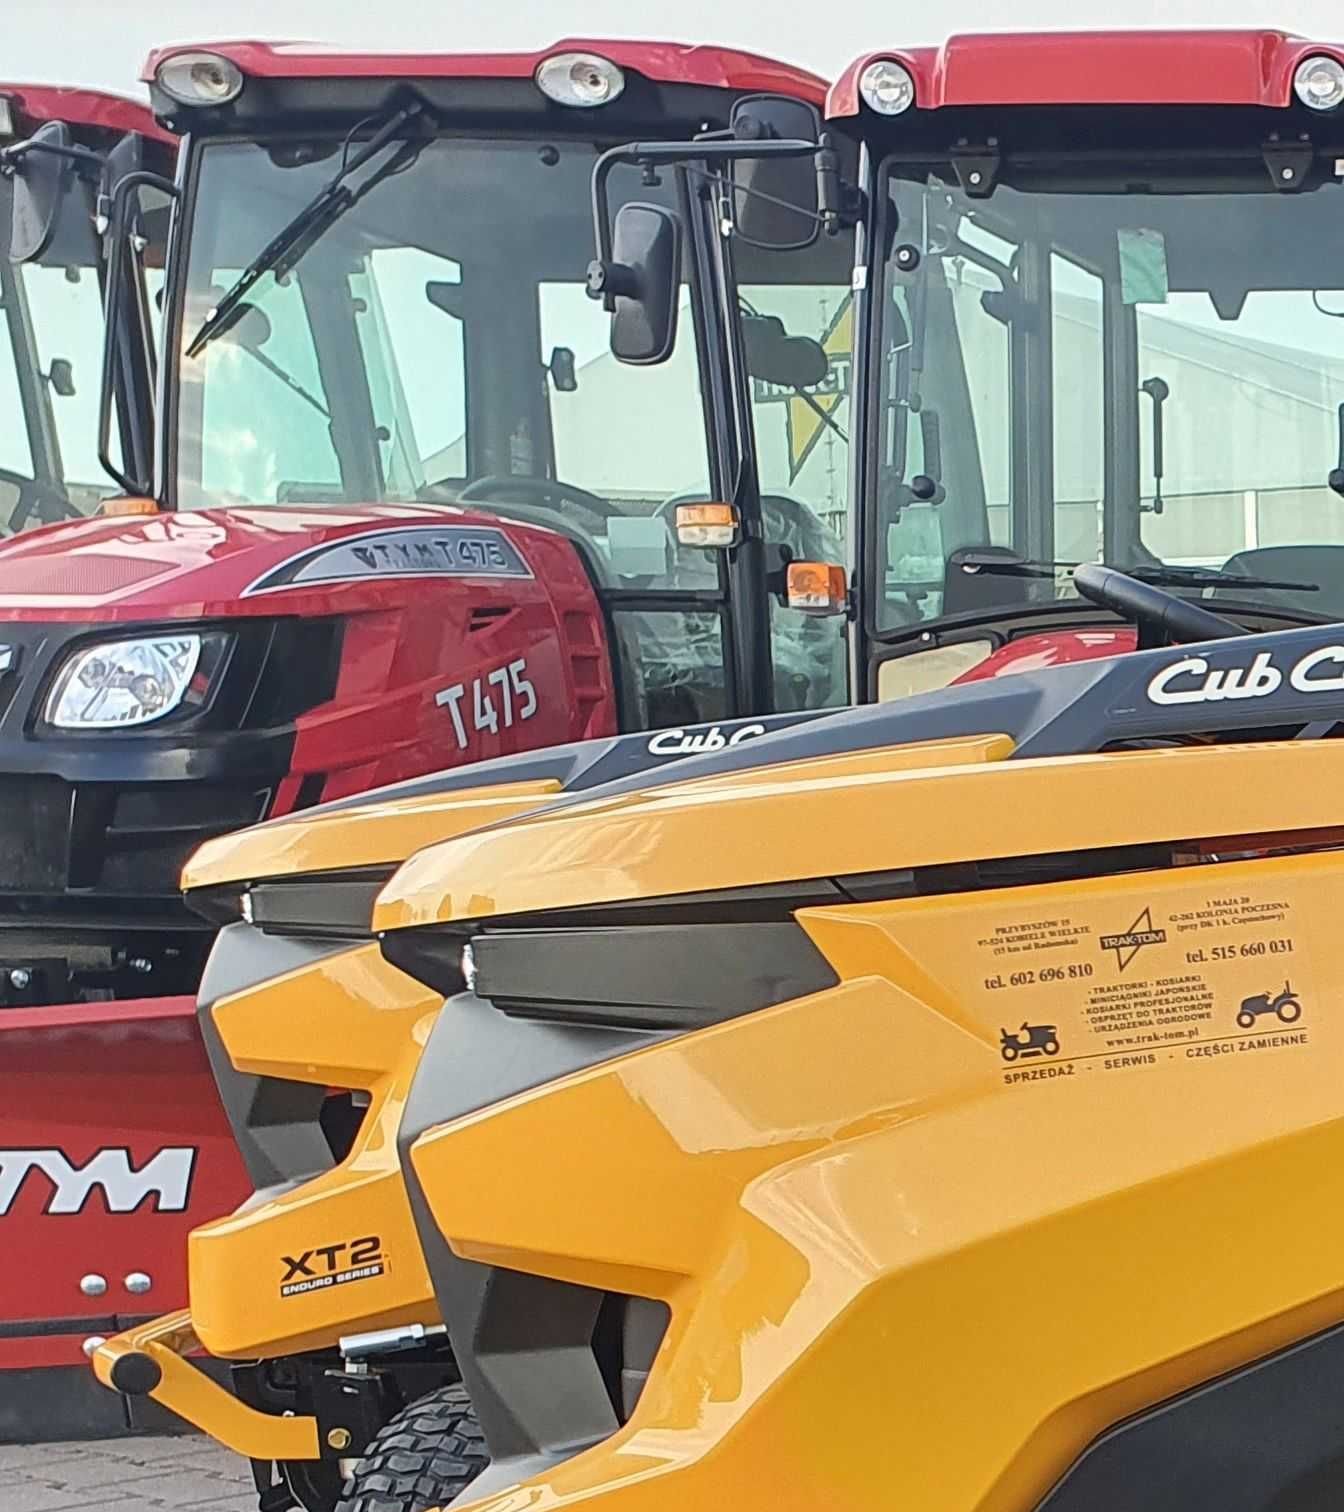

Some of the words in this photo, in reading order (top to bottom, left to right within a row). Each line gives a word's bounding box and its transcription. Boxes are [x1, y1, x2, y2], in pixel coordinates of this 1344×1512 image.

[434, 541, 508, 568] T475
[1147, 654, 1281, 704] Cub
[435, 659, 536, 749] T475
[648, 727, 725, 755] Cub
[1102, 931, 1164, 948] TRAK-TOM
[1186, 949, 1208, 963] tel.
[1211, 945, 1236, 961] 515
[1240, 942, 1265, 957] 660
[1270, 939, 1294, 953] 031
[984, 975, 1006, 990] tel.
[1010, 971, 1036, 986] 602
[1040, 967, 1065, 982] 696
[1069, 963, 1093, 977] 810
[1004, 1064, 1075, 1084] SPRZEDAŻ
[1104, 1053, 1156, 1070] SERWIS
[1185, 1042, 1235, 1059] CZĘŚCI
[1238, 1034, 1308, 1052] ZAMIENNE
[0, 1148, 194, 1214] TYM
[280, 1236, 382, 1281] XT2
[282, 1276, 333, 1294] ENDURO
[337, 1266, 379, 1282] SERIES
